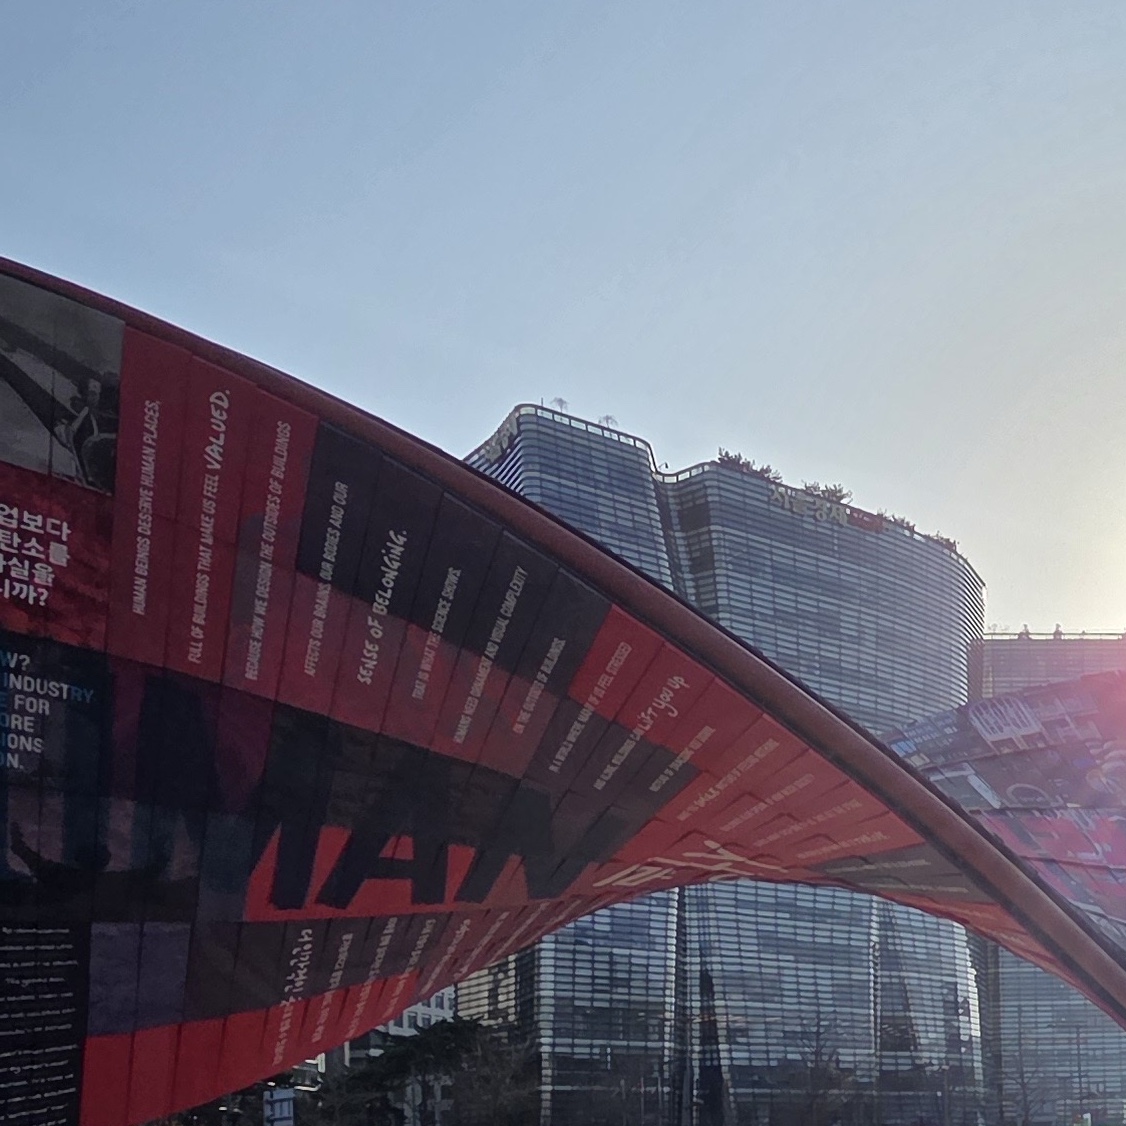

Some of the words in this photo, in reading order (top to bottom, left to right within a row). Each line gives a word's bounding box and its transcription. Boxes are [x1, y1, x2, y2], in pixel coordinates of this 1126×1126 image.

[204, 390, 231, 469] VALUED.
[271, 421, 292, 479] BUILDINGS
[141, 446, 156, 487] HUMAN
[203, 474, 220, 499] FEEL
[269, 478, 283, 494] OF
[333, 482, 349, 505] OUR
[137, 488, 154, 535] DESERVE
[203, 498, 217, 514] US
[329, 505, 345, 528] AND
[200, 514, 215, 545] MAKE
[135, 536, 151, 576] BEINGS
[197, 544, 213, 571] THAT
[260, 541, 275, 560] THE
[256, 561, 273, 598] DESIGN
[133, 577, 147, 615] HUMAN
[192, 572, 210, 625] BUILDINGS
[254, 598, 268, 615] WE
[191, 625, 205, 639] OF
[251, 615, 266, 639] HOW
[310, 618, 325, 638] OUR
[368, 616, 384, 638] OF
[188, 642, 204, 663] FULL
[245, 639, 263, 680] BECAUSE
[357, 640, 380, 684] SENSE
[3, 671, 94, 703] INDUSTRY
[14, 694, 50, 716] FOR
